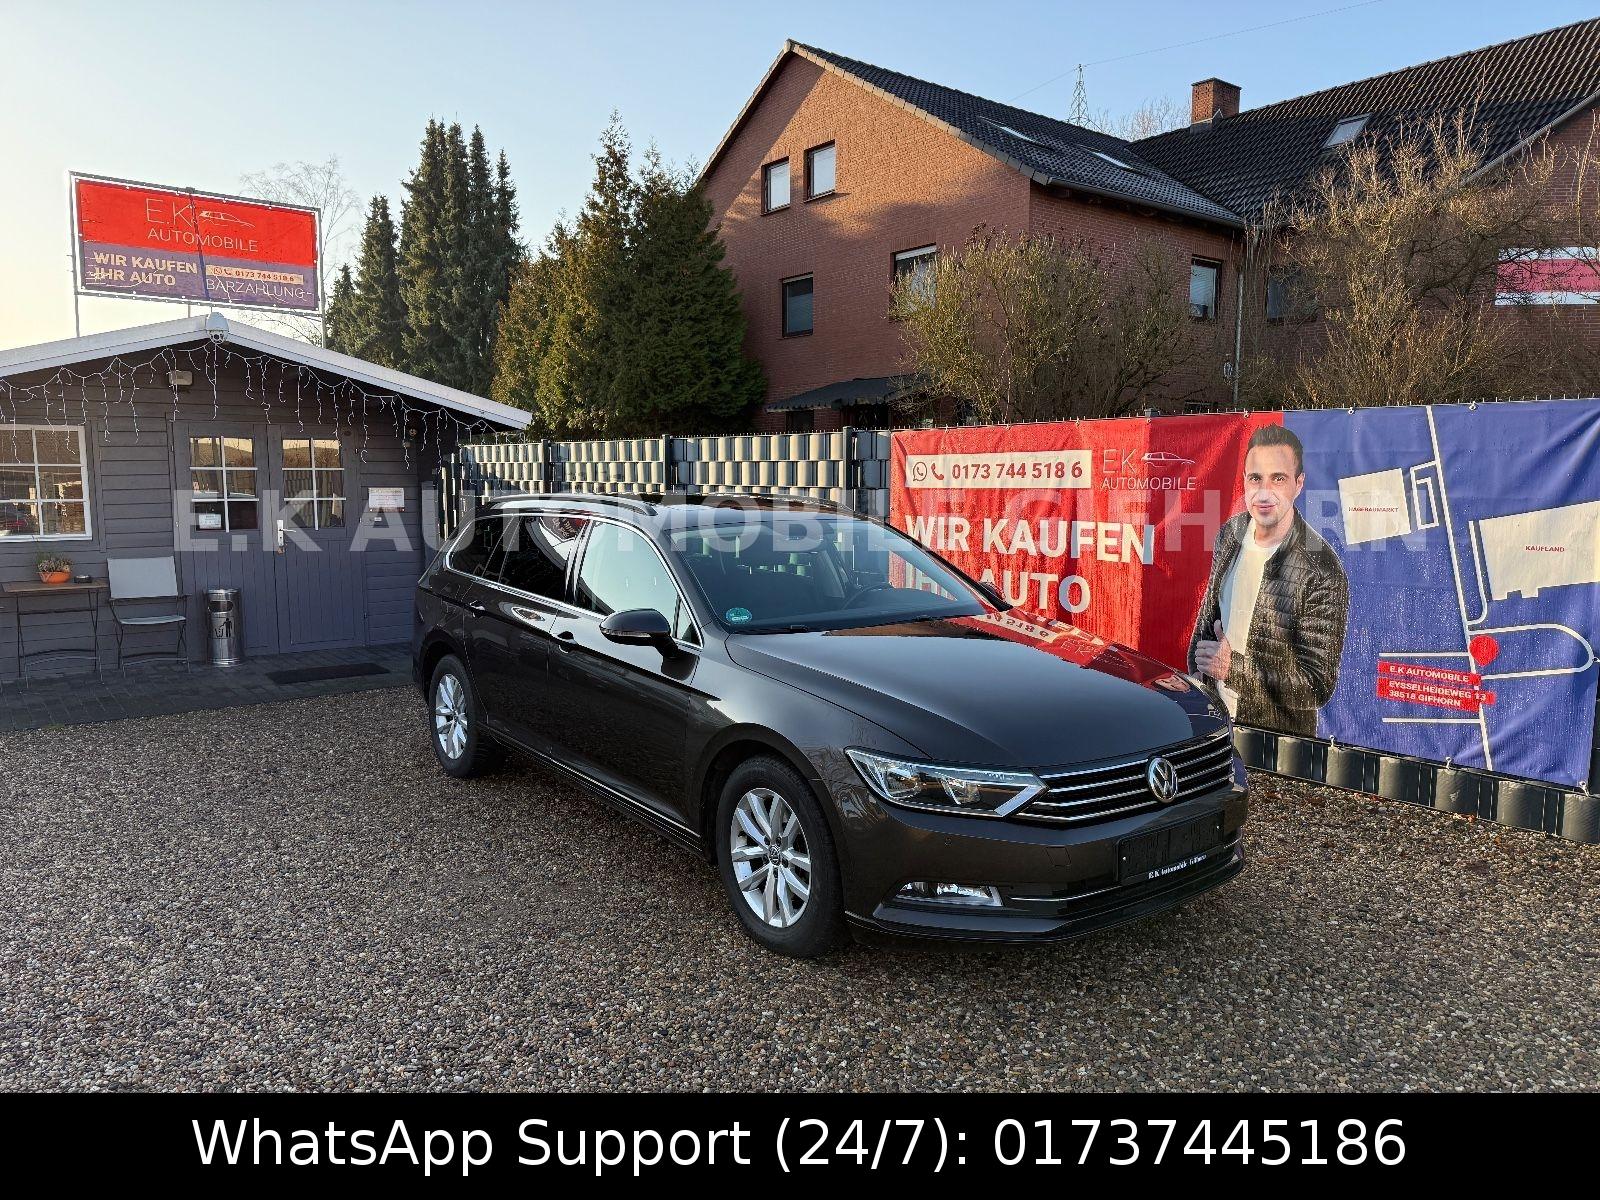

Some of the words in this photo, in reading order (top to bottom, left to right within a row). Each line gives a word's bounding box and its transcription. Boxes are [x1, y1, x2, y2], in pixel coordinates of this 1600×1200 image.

[147, 227, 258, 252] AUTOMOBILE
[93, 251, 127, 267] WIR
[131, 256, 198, 274] KAUFEN
[94, 267, 126, 281] IHR
[129, 271, 176, 286] AUTO
[235, 270, 255, 278] 0173
[257, 272, 272, 280] 744
[206, 278, 305, 299] BARZAHLUNG
[951, 463, 991, 480] 0173
[996, 462, 1027, 479] 744
[1031, 461, 1065, 479] 518
[1071, 460, 1083, 478] 6
[1101, 476, 1197, 490] AUTOMOBILE
[905, 514, 970, 552] WIR
[982, 518, 1155, 566] KAUFEN
[1525, 545, 1565, 553] KAUFLAND
[1406, 667, 1469, 683] AUTOMOBILE
[1389, 680, 1472, 699] EYSSELHEIDEWEG
[1474, 693, 1487, 701] 13
[1389, 690, 1416, 700] 38518
[1418, 694, 1461, 707] GIFHORN
